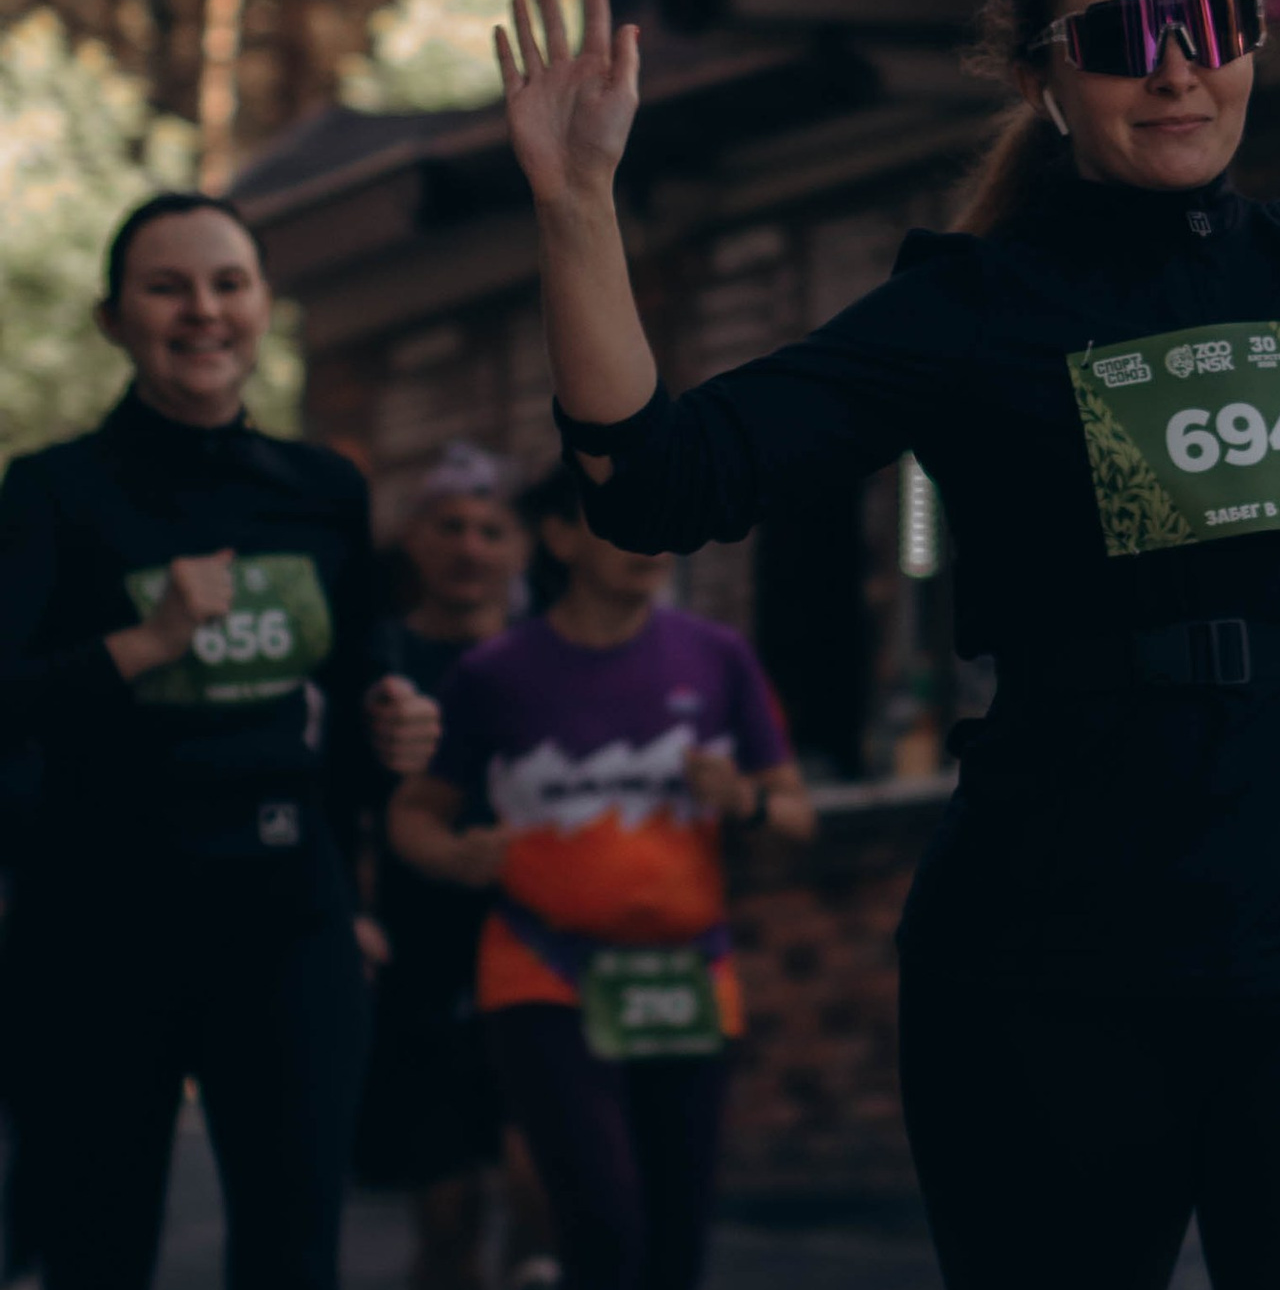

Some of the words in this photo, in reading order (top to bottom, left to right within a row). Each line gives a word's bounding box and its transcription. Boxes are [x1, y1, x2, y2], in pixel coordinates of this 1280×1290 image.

[1193, 341, 1232, 359] ZOO
[1249, 336, 1277, 353] 30
[1096, 356, 1141, 374] СПОРТ
[1196, 355, 1236, 375] NSK
[1106, 368, 1149, 385] СОЮЗ
[1204, 502, 1260, 526] ЗАБЕГ
[1263, 502, 1278, 517] В
[191, 610, 293, 666] 656
